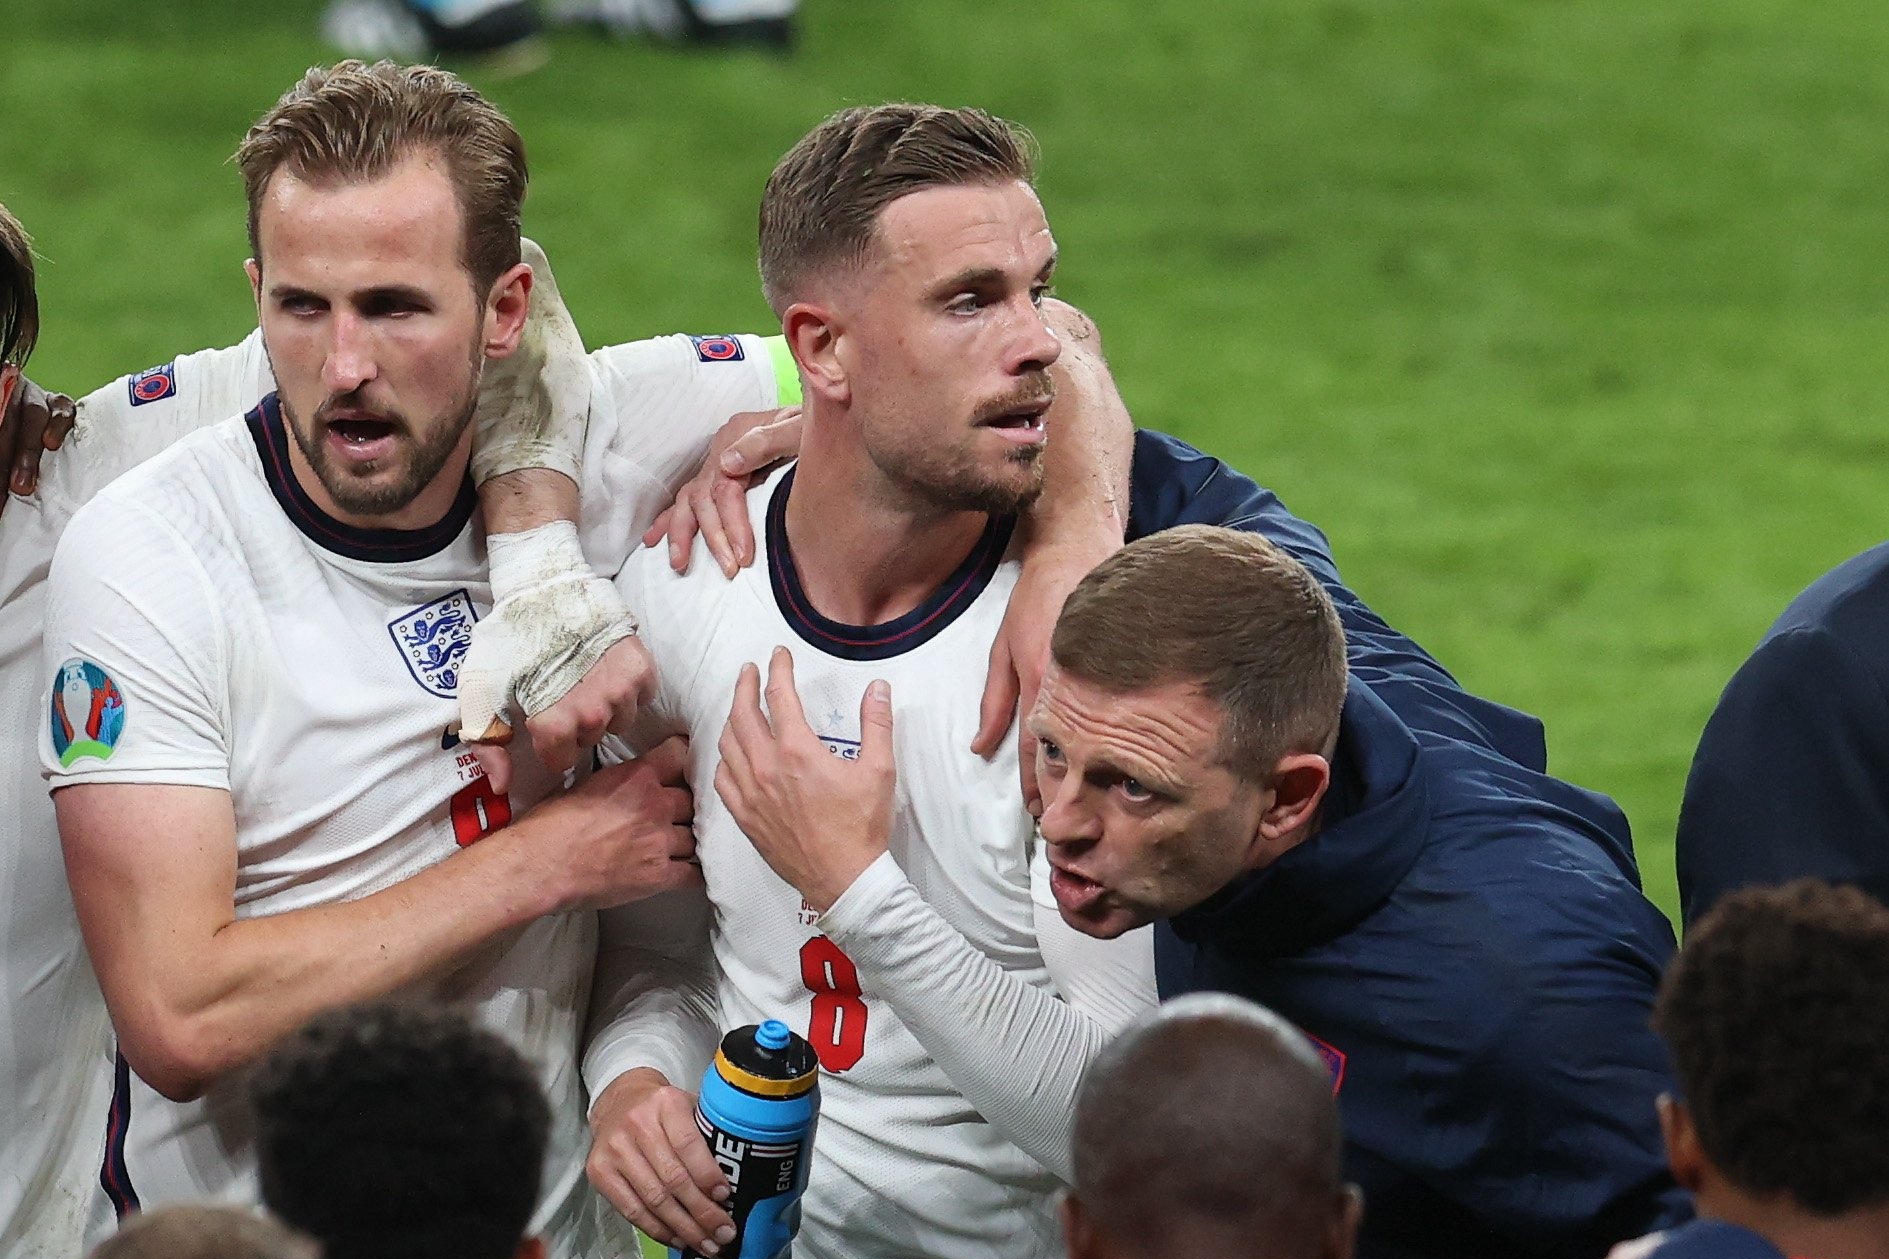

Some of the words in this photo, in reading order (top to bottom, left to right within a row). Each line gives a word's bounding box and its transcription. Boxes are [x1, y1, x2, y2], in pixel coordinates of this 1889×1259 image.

[457, 771, 464, 781] 7
[468, 763, 486, 778] JUL
[799, 934, 868, 1074] 8
[776, 1160, 794, 1192] ENG
